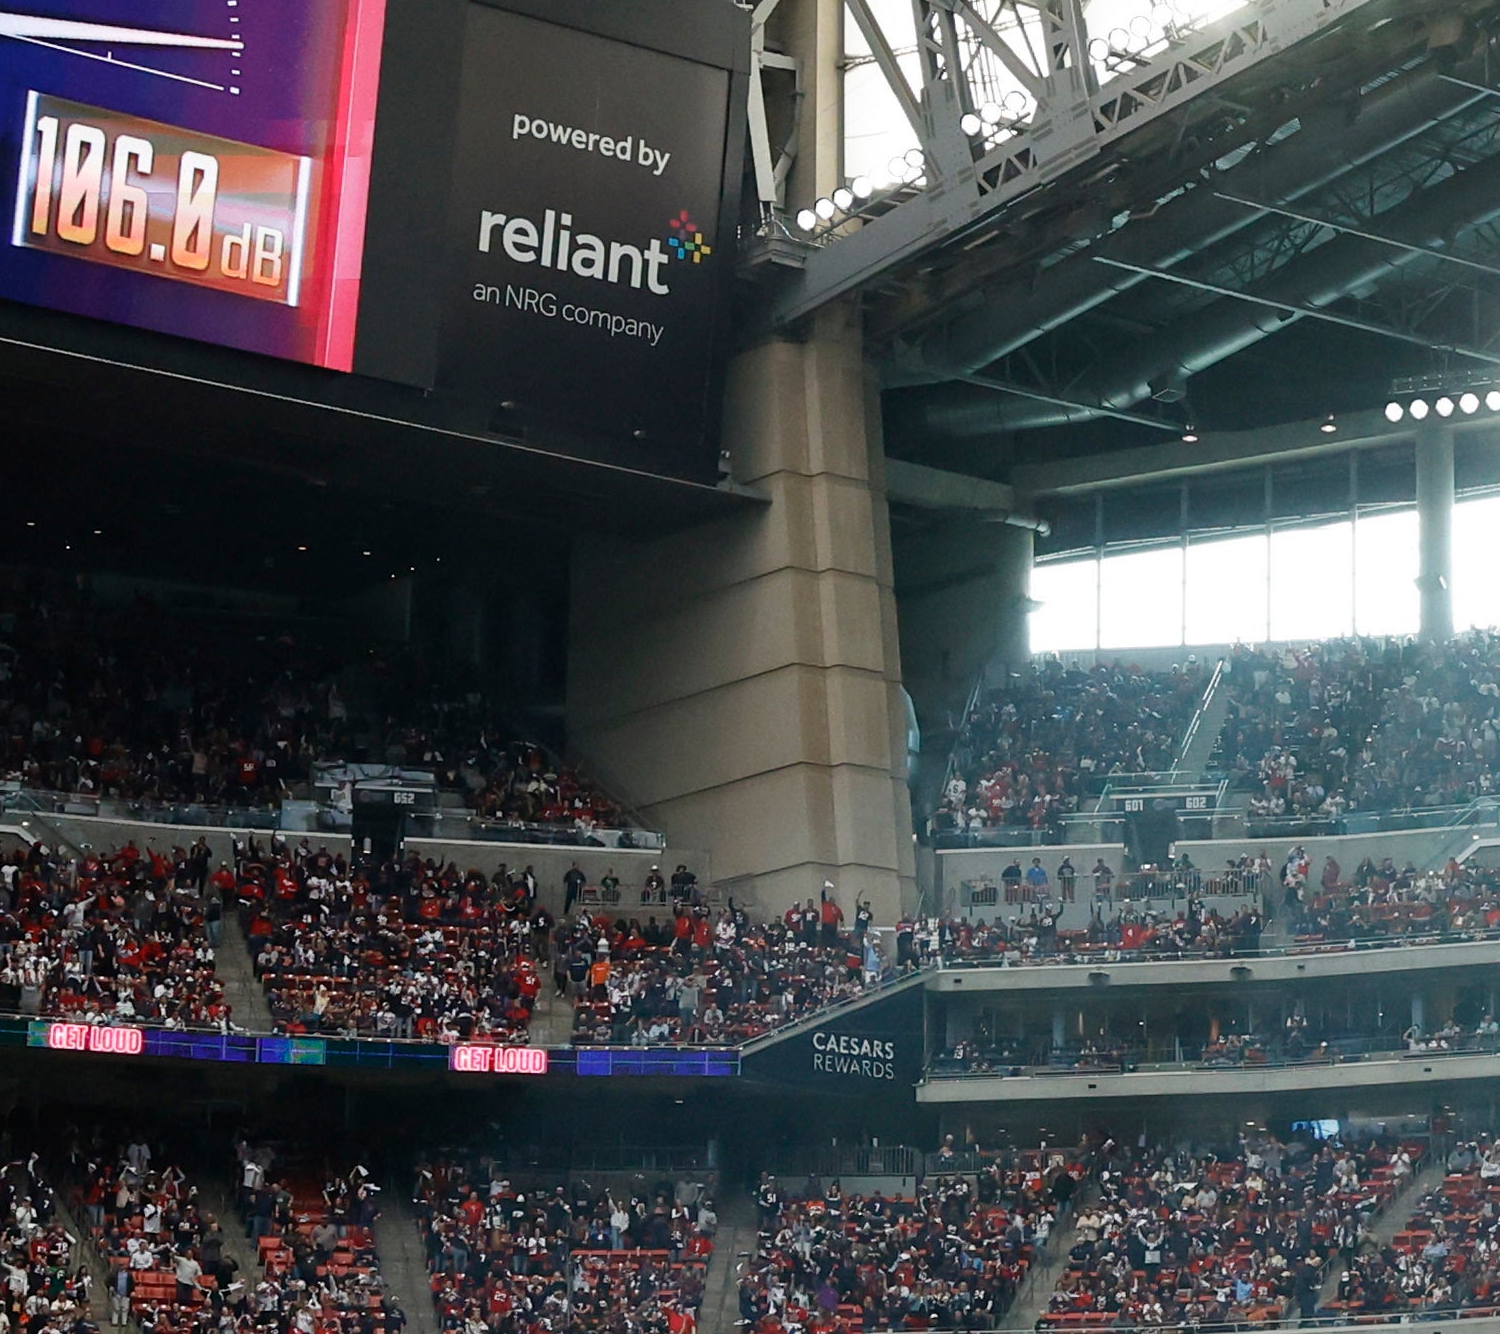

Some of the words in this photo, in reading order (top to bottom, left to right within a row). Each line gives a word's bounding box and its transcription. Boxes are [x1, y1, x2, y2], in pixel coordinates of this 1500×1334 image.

[513, 113, 632, 161] powered
[638, 139, 670, 176] by
[32, 116, 219, 268] 106.0
[220, 224, 285, 286] dB
[478, 209, 670, 295] reliant
[473, 283, 499, 302] an
[505, 284, 557, 317] NRG
[562, 303, 664, 346] company
[1125, 799, 1143, 811] 601
[1186, 797, 1207, 809] 602
[50, 1024, 88, 1049] GET
[90, 1025, 141, 1053] LOUD
[812, 1030, 895, 1060] CAESARS
[455, 1046, 492, 1071] GET
[494, 1046, 545, 1073] LOUD
[812, 1052, 895, 1080] REWARDS
